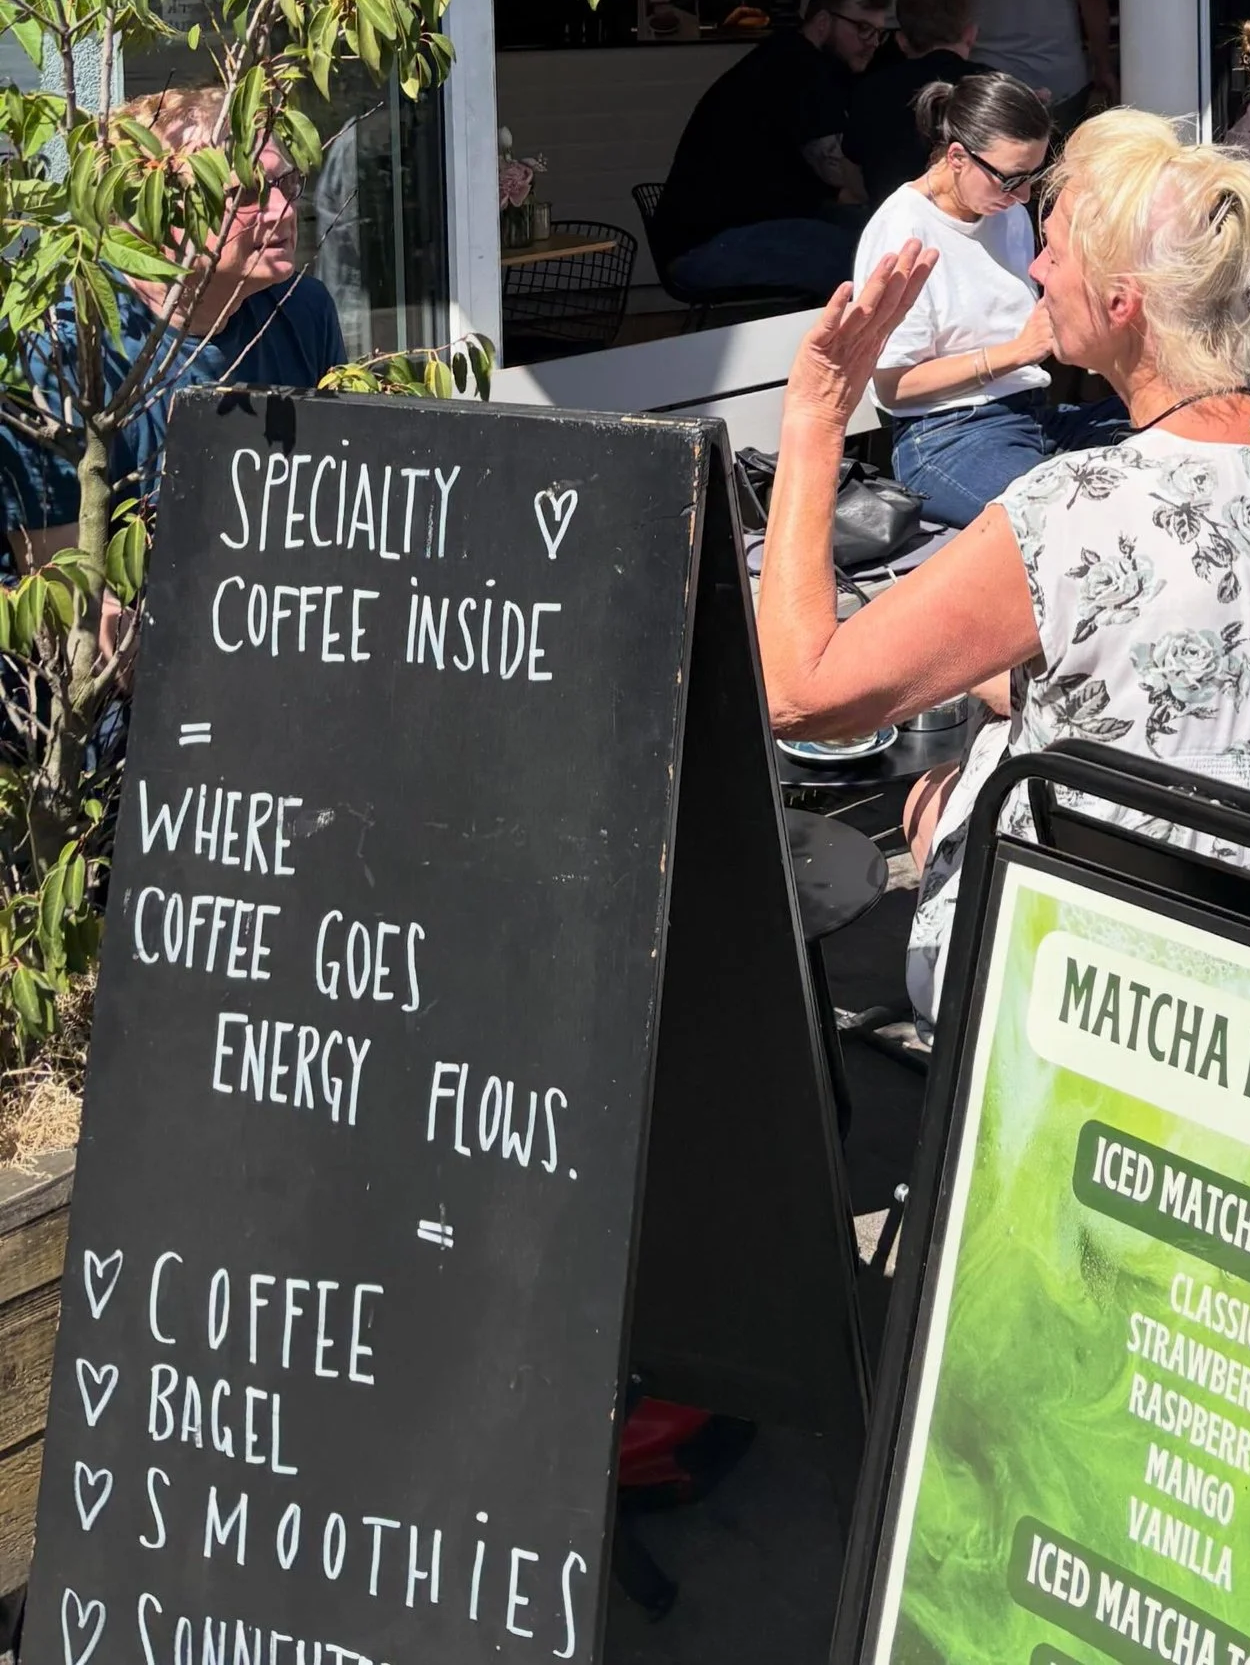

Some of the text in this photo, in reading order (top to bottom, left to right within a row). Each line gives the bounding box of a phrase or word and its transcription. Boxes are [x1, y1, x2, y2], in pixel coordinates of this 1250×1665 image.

[211, 575, 380, 663] COFFEE
[138, 778, 304, 877] WHERE
[134, 886, 426, 1013] COFFEE GOES
[1058, 956, 1230, 1089] MATCHA
[212, 1012, 579, 1180] ENERGY FLOWS.
[1091, 1136, 1154, 1203] ICED
[149, 1251, 384, 1385] COFFEE
[149, 1363, 298, 1475] BAGEL
[1144, 1442, 1235, 1526] MANGO
[1026, 1534, 1217, 1665] ICED MATCHA
[1128, 1496, 1233, 1593] VANILLA
